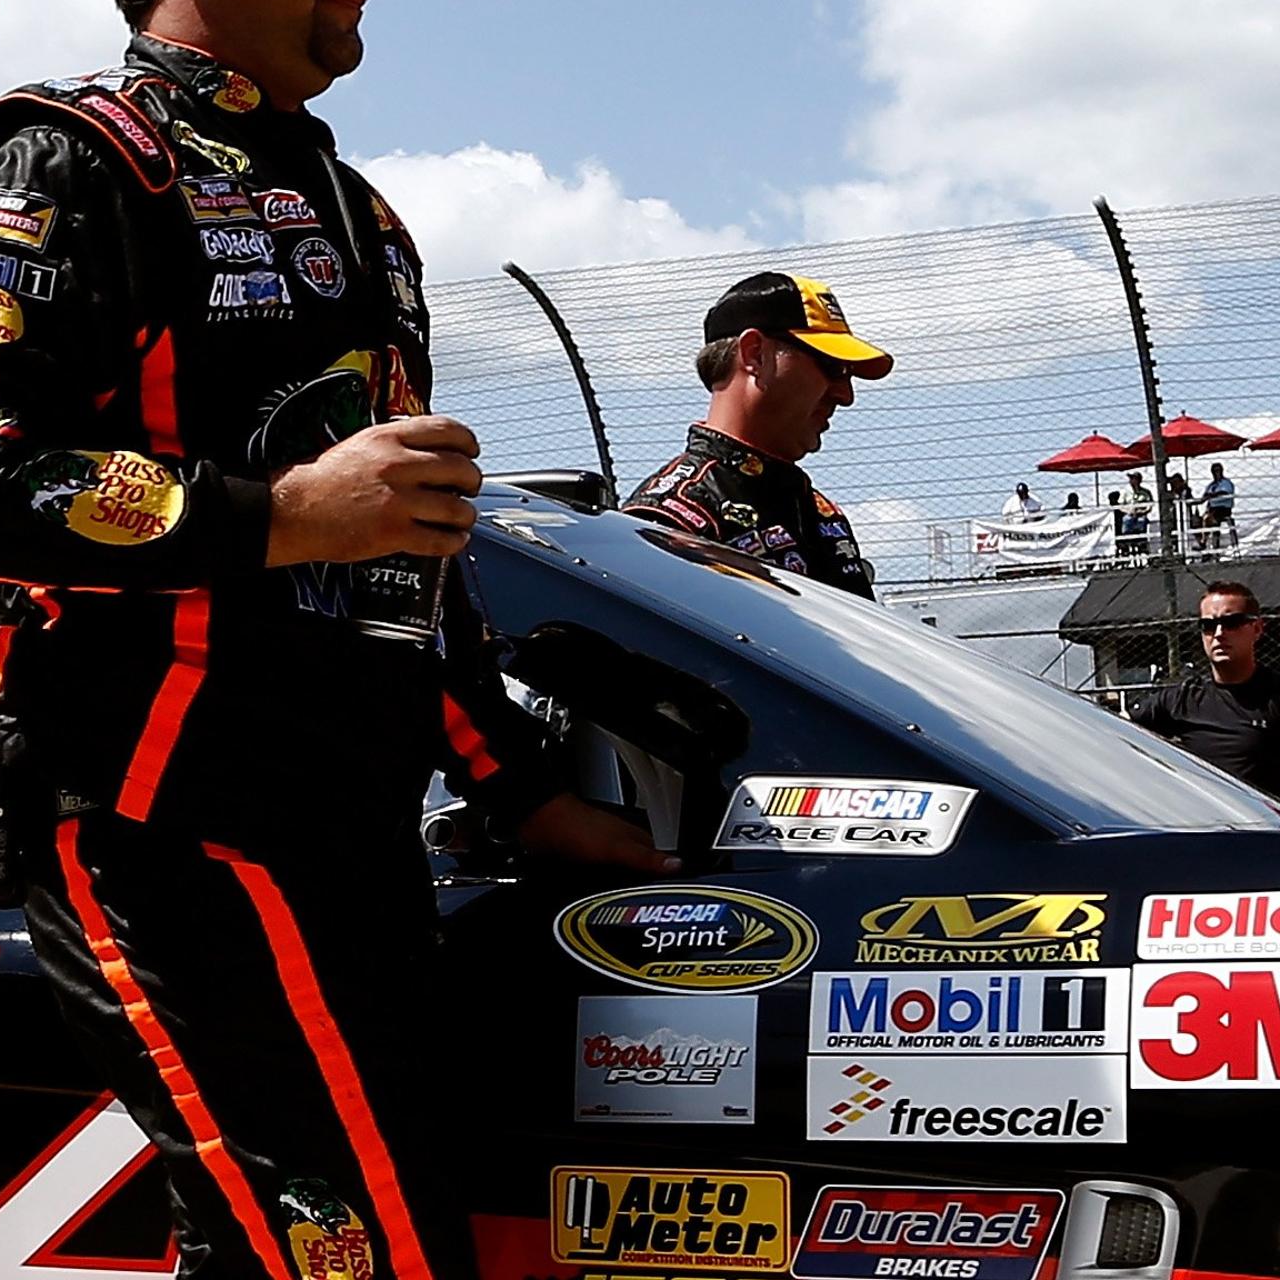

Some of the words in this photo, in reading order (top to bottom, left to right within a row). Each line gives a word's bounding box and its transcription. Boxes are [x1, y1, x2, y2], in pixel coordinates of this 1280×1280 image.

[78, 93, 160, 158] SIMPSON
[99, 452, 168, 488] Bass
[97, 475, 146, 504] Pro
[90, 496, 169, 539] Shops
[1003, 529, 1036, 543] Haas
[730, 824, 836, 843] RACE
[844, 826, 930, 846] CAR
[631, 903, 722, 924] NASCAR
[641, 925, 729, 954] Sprint
[853, 940, 1008, 965] MECHANIX
[1012, 937, 1101, 963] WEAR
[1145, 942, 1247, 954] THROTTLE
[646, 963, 695, 978] CUP
[697, 961, 782, 977] SERIES
[827, 976, 1021, 1034] Mobil
[1059, 978, 1086, 1029] 1
[583, 1035, 666, 1069] Coors
[663, 1046, 749, 1068] LIGHT
[826, 1034, 894, 1049] OFFICIAL
[897, 1034, 956, 1049] MOTOR
[958, 1034, 985, 1049] OIL
[987, 1034, 1000, 1049] &
[1004, 1033, 1106, 1049] LUBRICANTS
[604, 1068, 722, 1086] POLE
[888, 1097, 1105, 1137] freescale
[616, 1176, 749, 1217] Auto
[610, 1214, 778, 1257] Meter
[820, 1201, 1041, 1249] Duralast
[323, 1232, 348, 1274] Pro
[622, 1252, 692, 1265] COMPETITION
[694, 1254, 772, 1267] INSTRUMENTS
[874, 1258, 980, 1279] BRAKES
